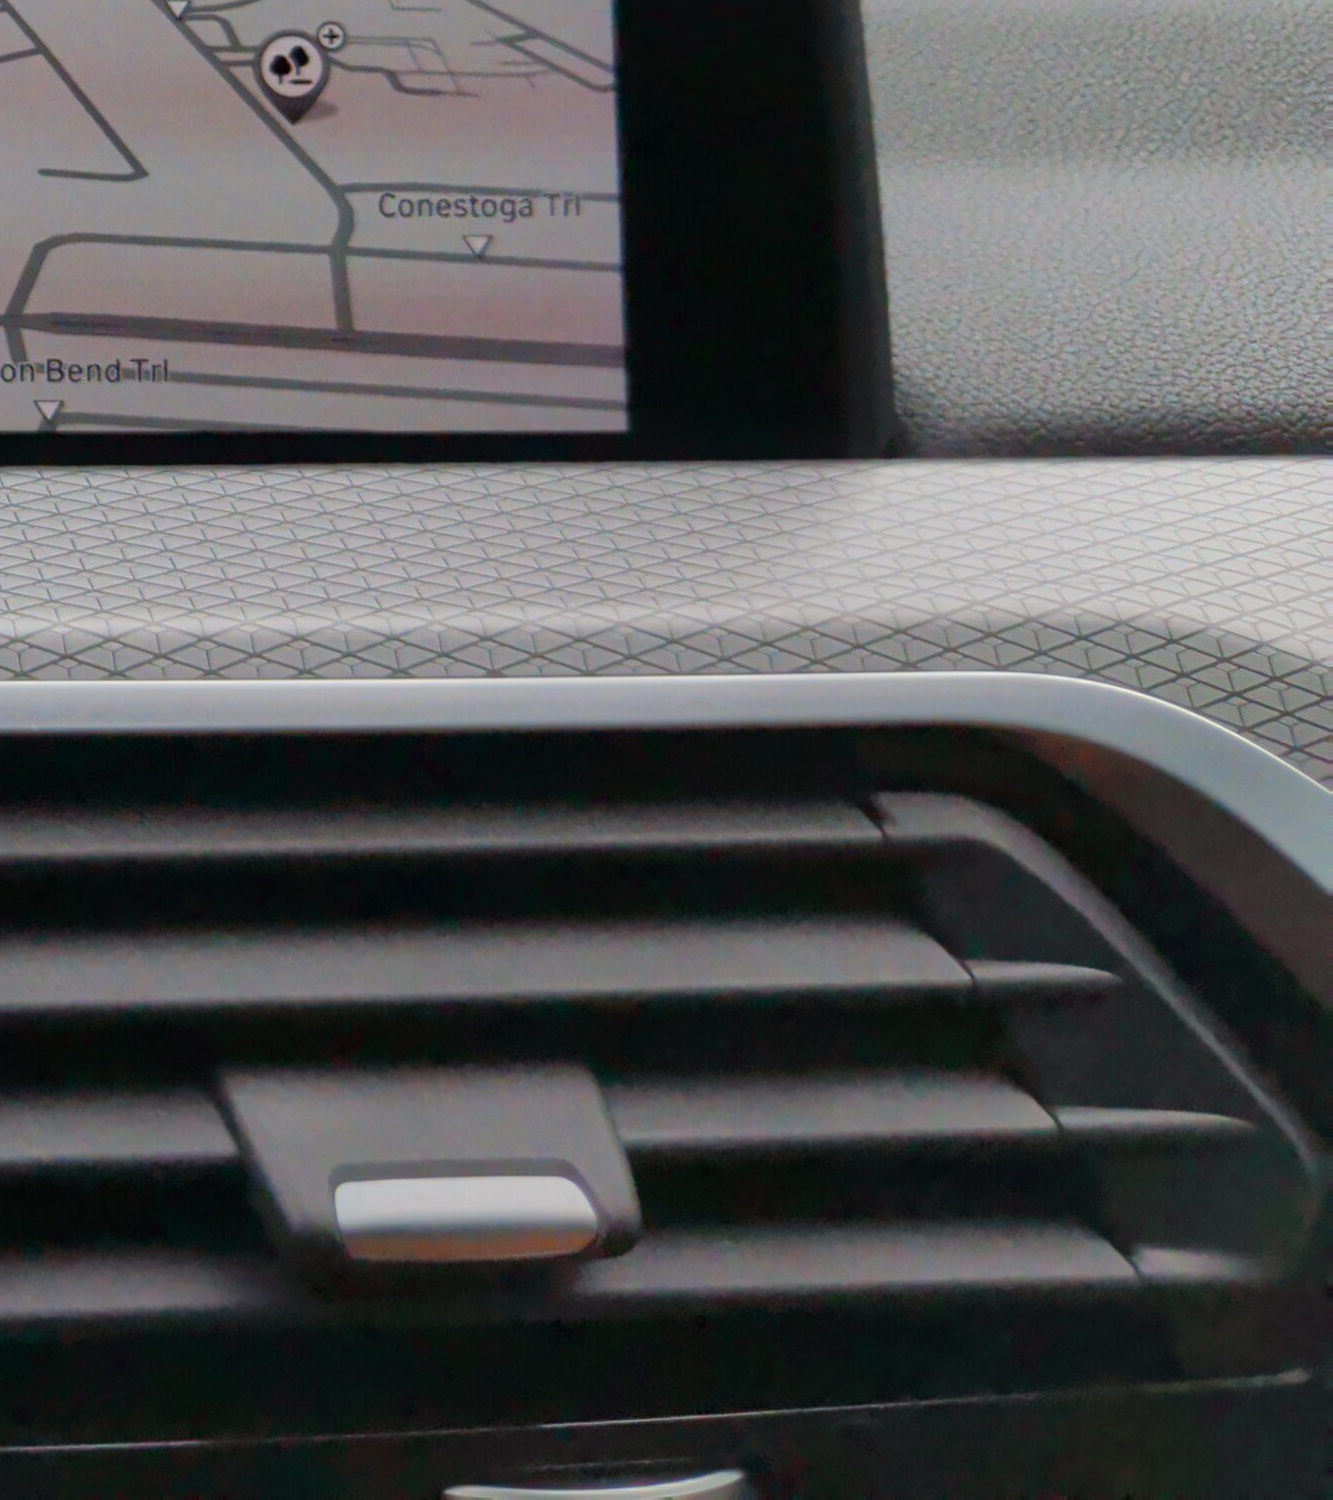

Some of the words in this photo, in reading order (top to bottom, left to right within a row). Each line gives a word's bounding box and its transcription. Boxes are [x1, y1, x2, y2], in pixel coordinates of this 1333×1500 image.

[378, 192, 534, 223] Conestoga
[543, 192, 582, 217] Trl
[45, 357, 121, 383] Bend
[129, 357, 170, 383] Trl
